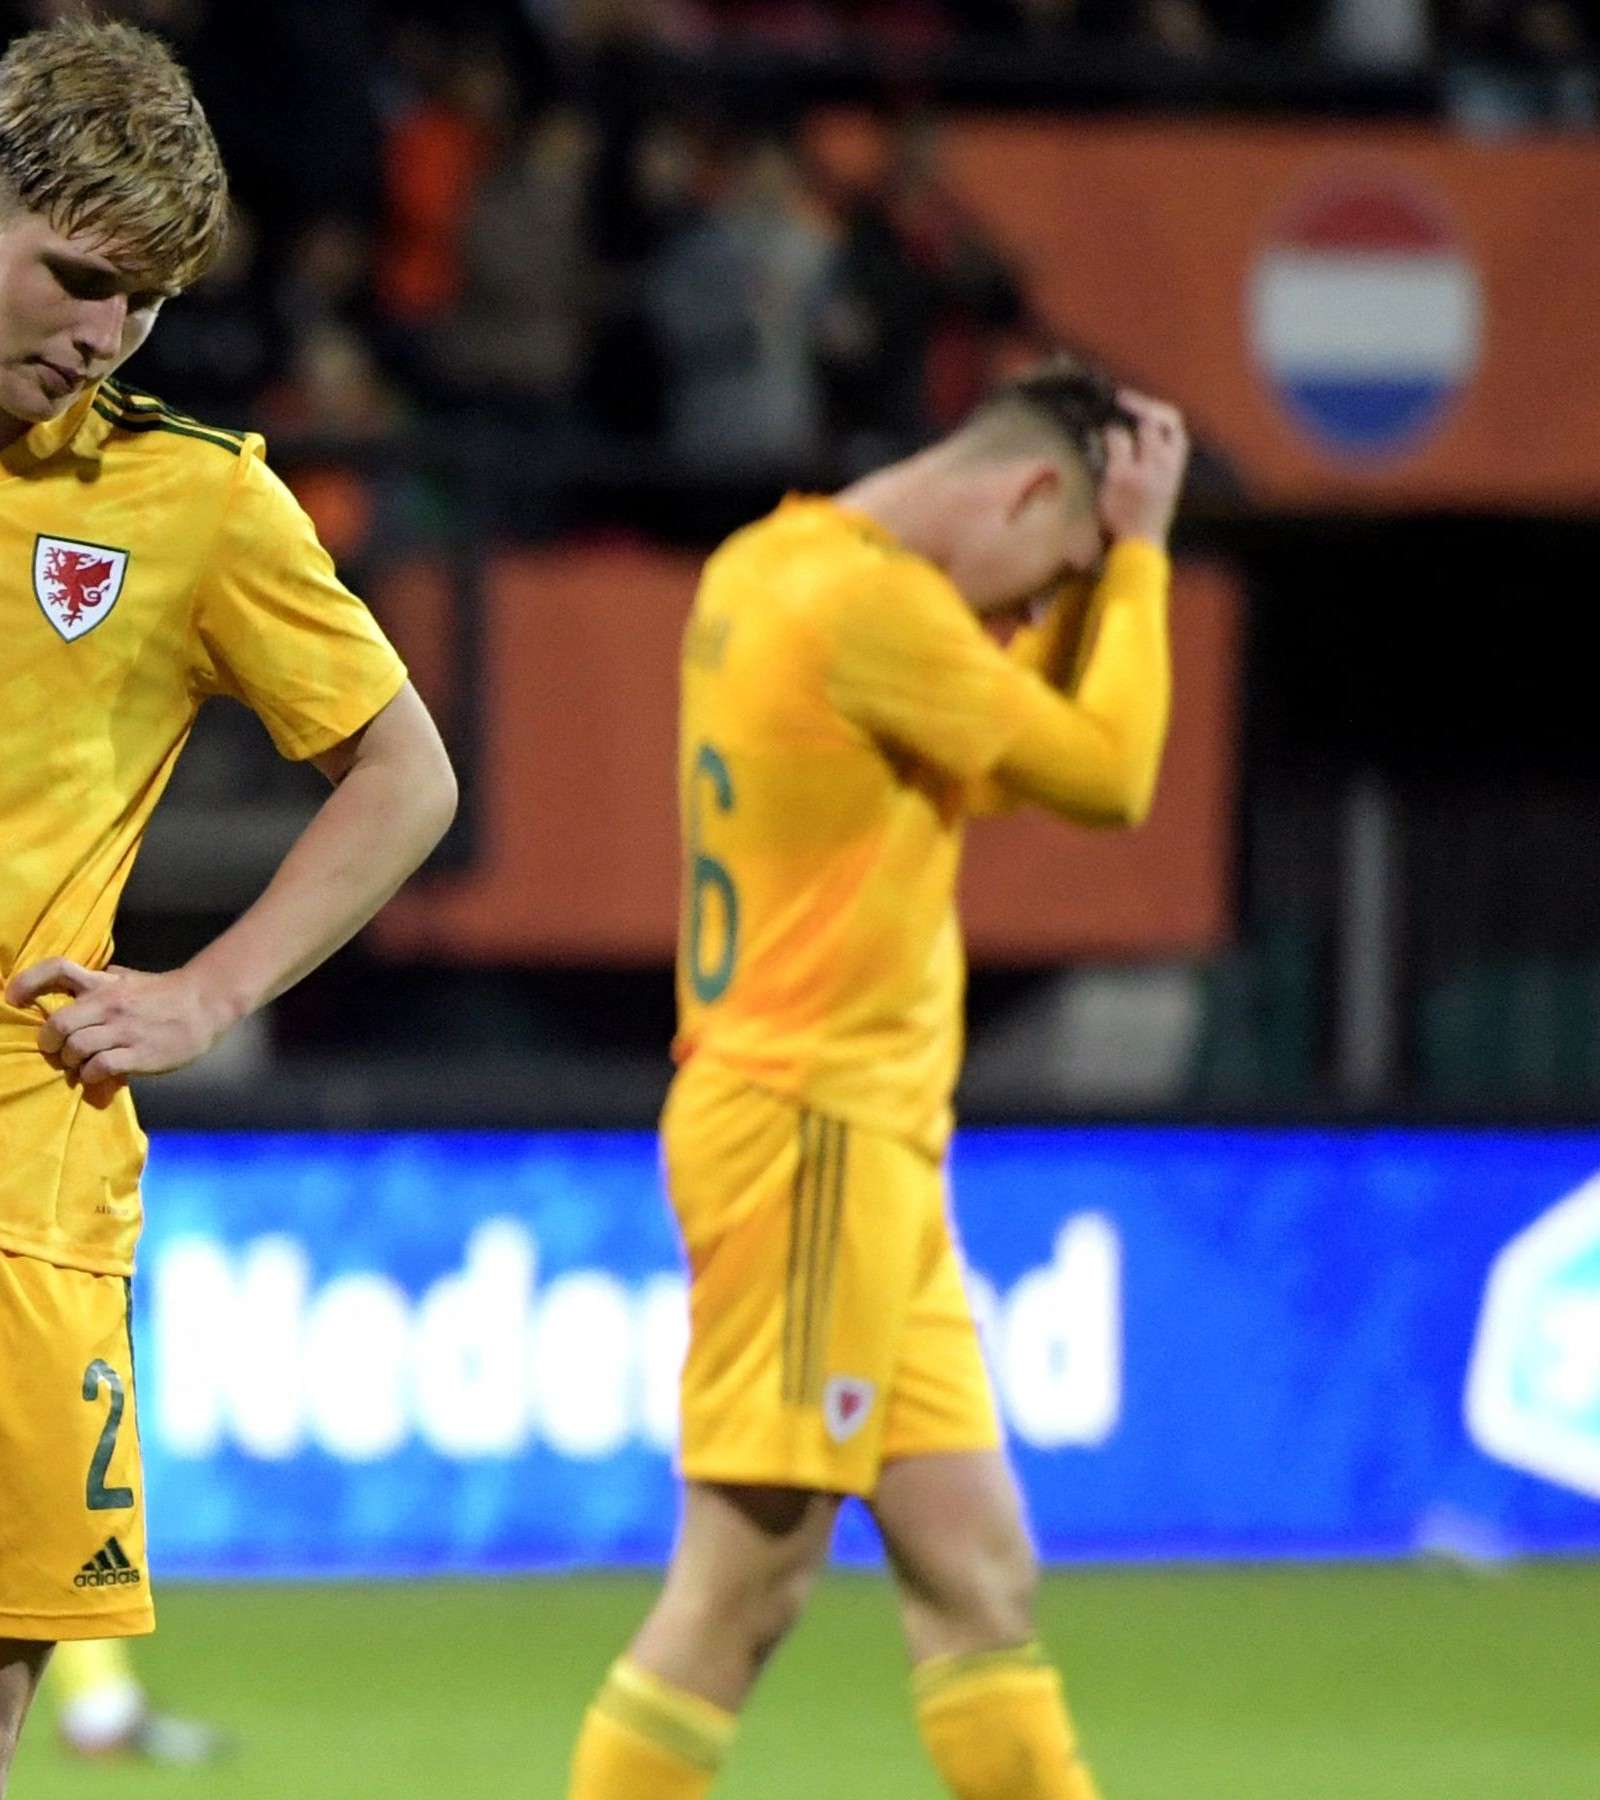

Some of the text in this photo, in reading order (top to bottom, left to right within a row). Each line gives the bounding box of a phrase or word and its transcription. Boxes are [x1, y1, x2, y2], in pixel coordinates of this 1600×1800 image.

[690, 743, 738, 1003] 6
[82, 1358, 134, 1510] 2
[73, 1567, 140, 1587] adidas
